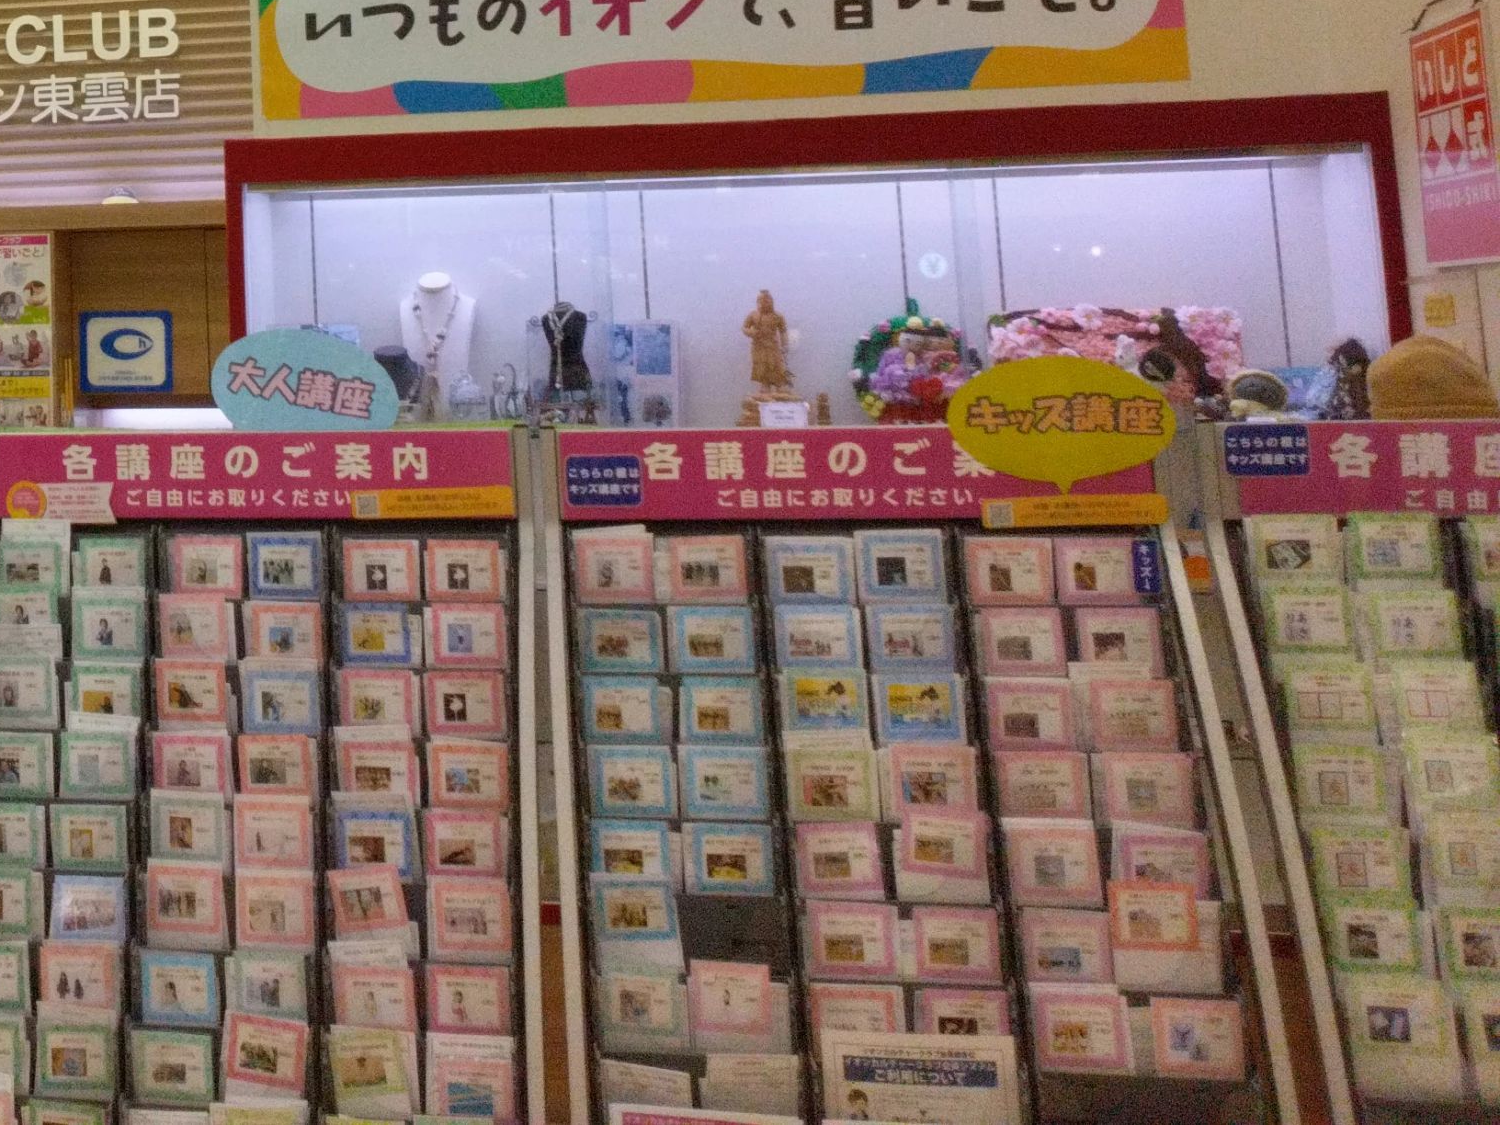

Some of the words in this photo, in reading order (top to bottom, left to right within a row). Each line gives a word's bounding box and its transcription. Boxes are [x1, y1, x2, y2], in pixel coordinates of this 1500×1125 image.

[6, 7, 182, 65] CLUB
[227, 357, 376, 420] 大人講座
[966, 393, 1165, 435] キッズ講座
[61, 442, 430, 483] 各講座のご案内
